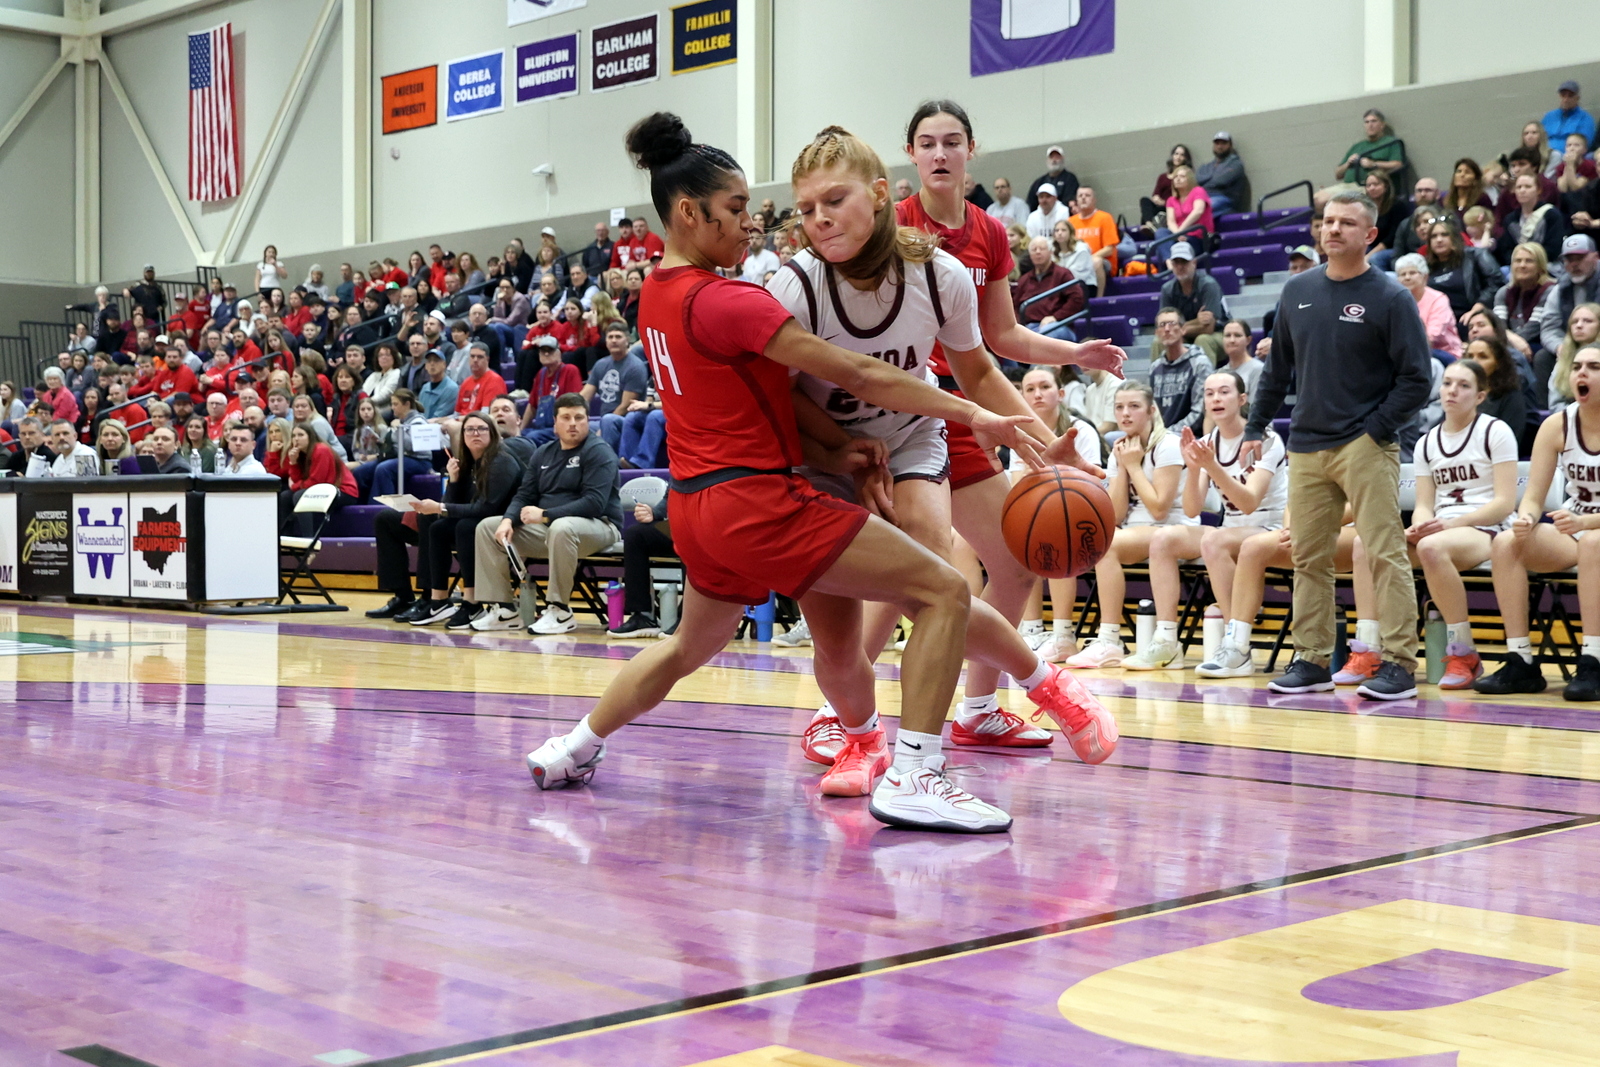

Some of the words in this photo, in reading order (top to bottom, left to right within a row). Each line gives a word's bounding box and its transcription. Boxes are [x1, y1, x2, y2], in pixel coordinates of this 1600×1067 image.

[685, 9, 731, 32] FRANKLIN
[595, 28, 653, 56] EARLHAM
[684, 33, 731, 56] COLLEGE
[524, 49, 569, 71] BLUFFTON
[596, 54, 650, 80] COLLEGE
[458, 68, 491, 87] BEREA
[518, 65, 575, 89] UNIVERSITY
[394, 82, 424, 97] ANDERSON
[453, 82, 496, 104] COLLEGE
[391, 102, 426, 118] UNIVERSITY
[646, 326, 683, 396] 14
[1434, 463, 1479, 485] GENOA
[137, 520, 182, 536] FARMERS
[77, 532, 125, 547] Wannemacher
[132, 536, 187, 553] EQUIPMENT
